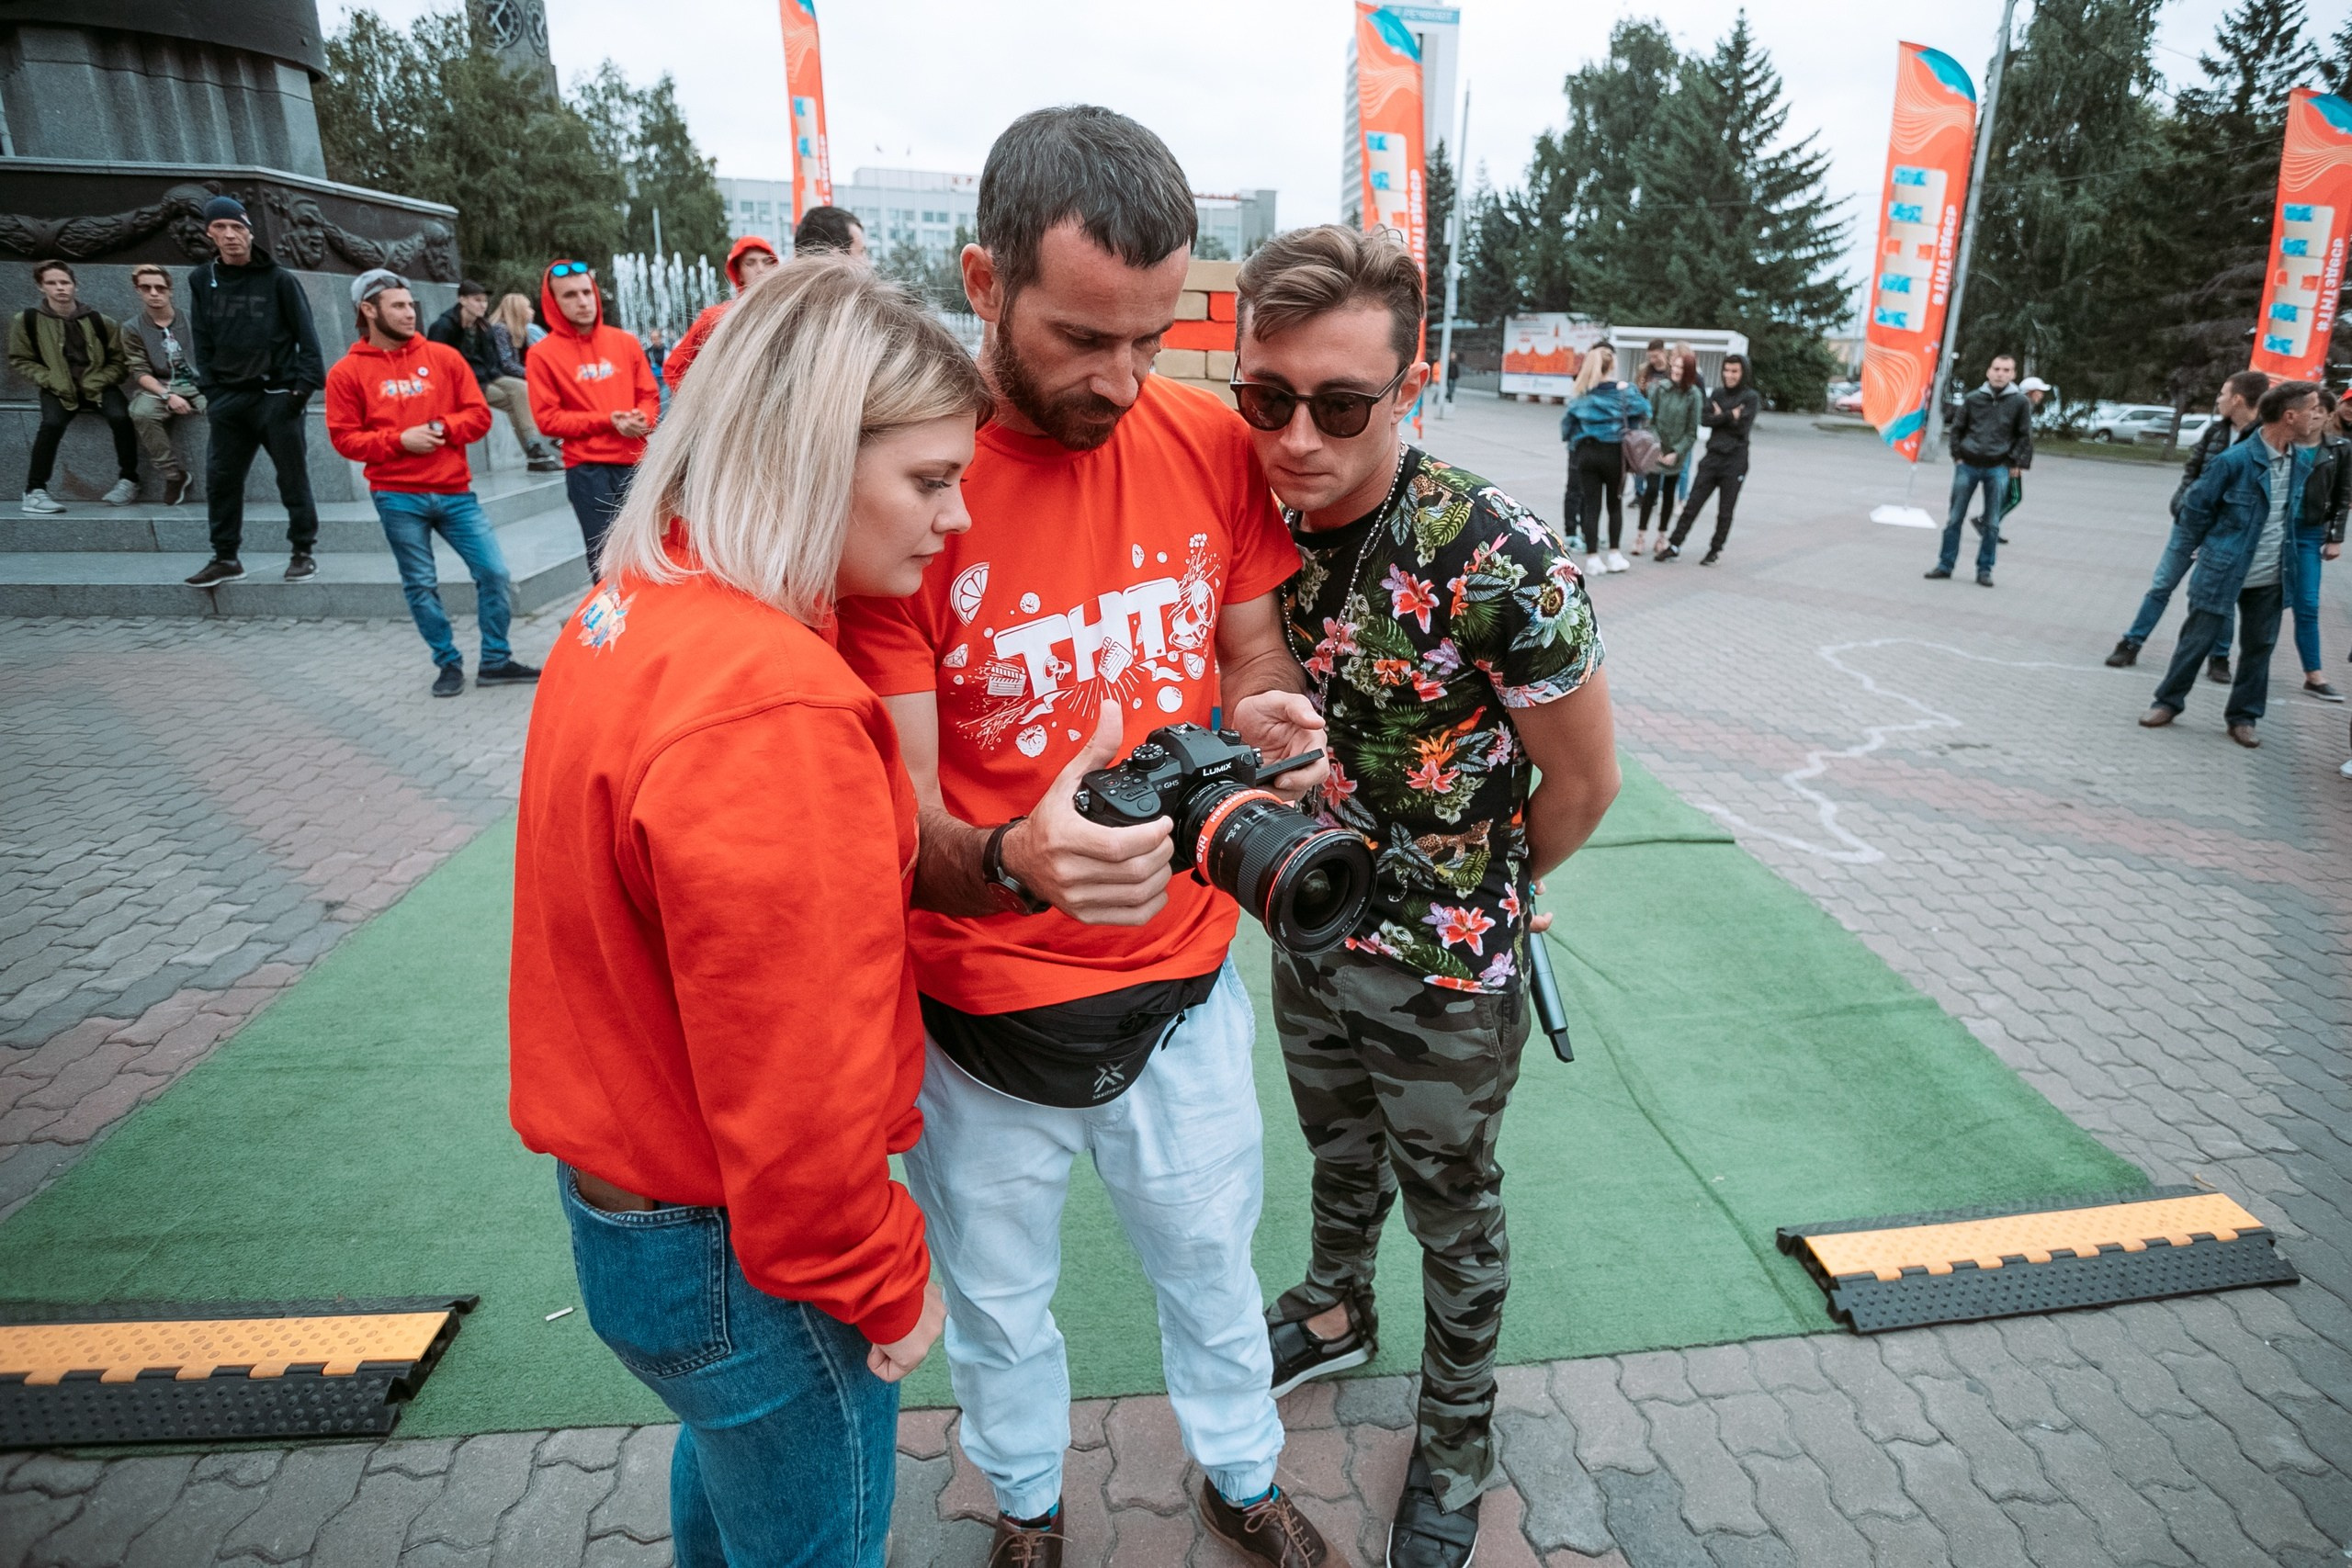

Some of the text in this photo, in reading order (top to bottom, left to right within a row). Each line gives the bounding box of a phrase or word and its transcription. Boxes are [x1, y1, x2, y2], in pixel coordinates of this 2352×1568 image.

[209, 294, 267, 318] UFC
[993, 577, 1182, 700] ТНТ
[1202, 761, 1233, 777] LUMIX
[1163, 779, 1180, 789] GH5
